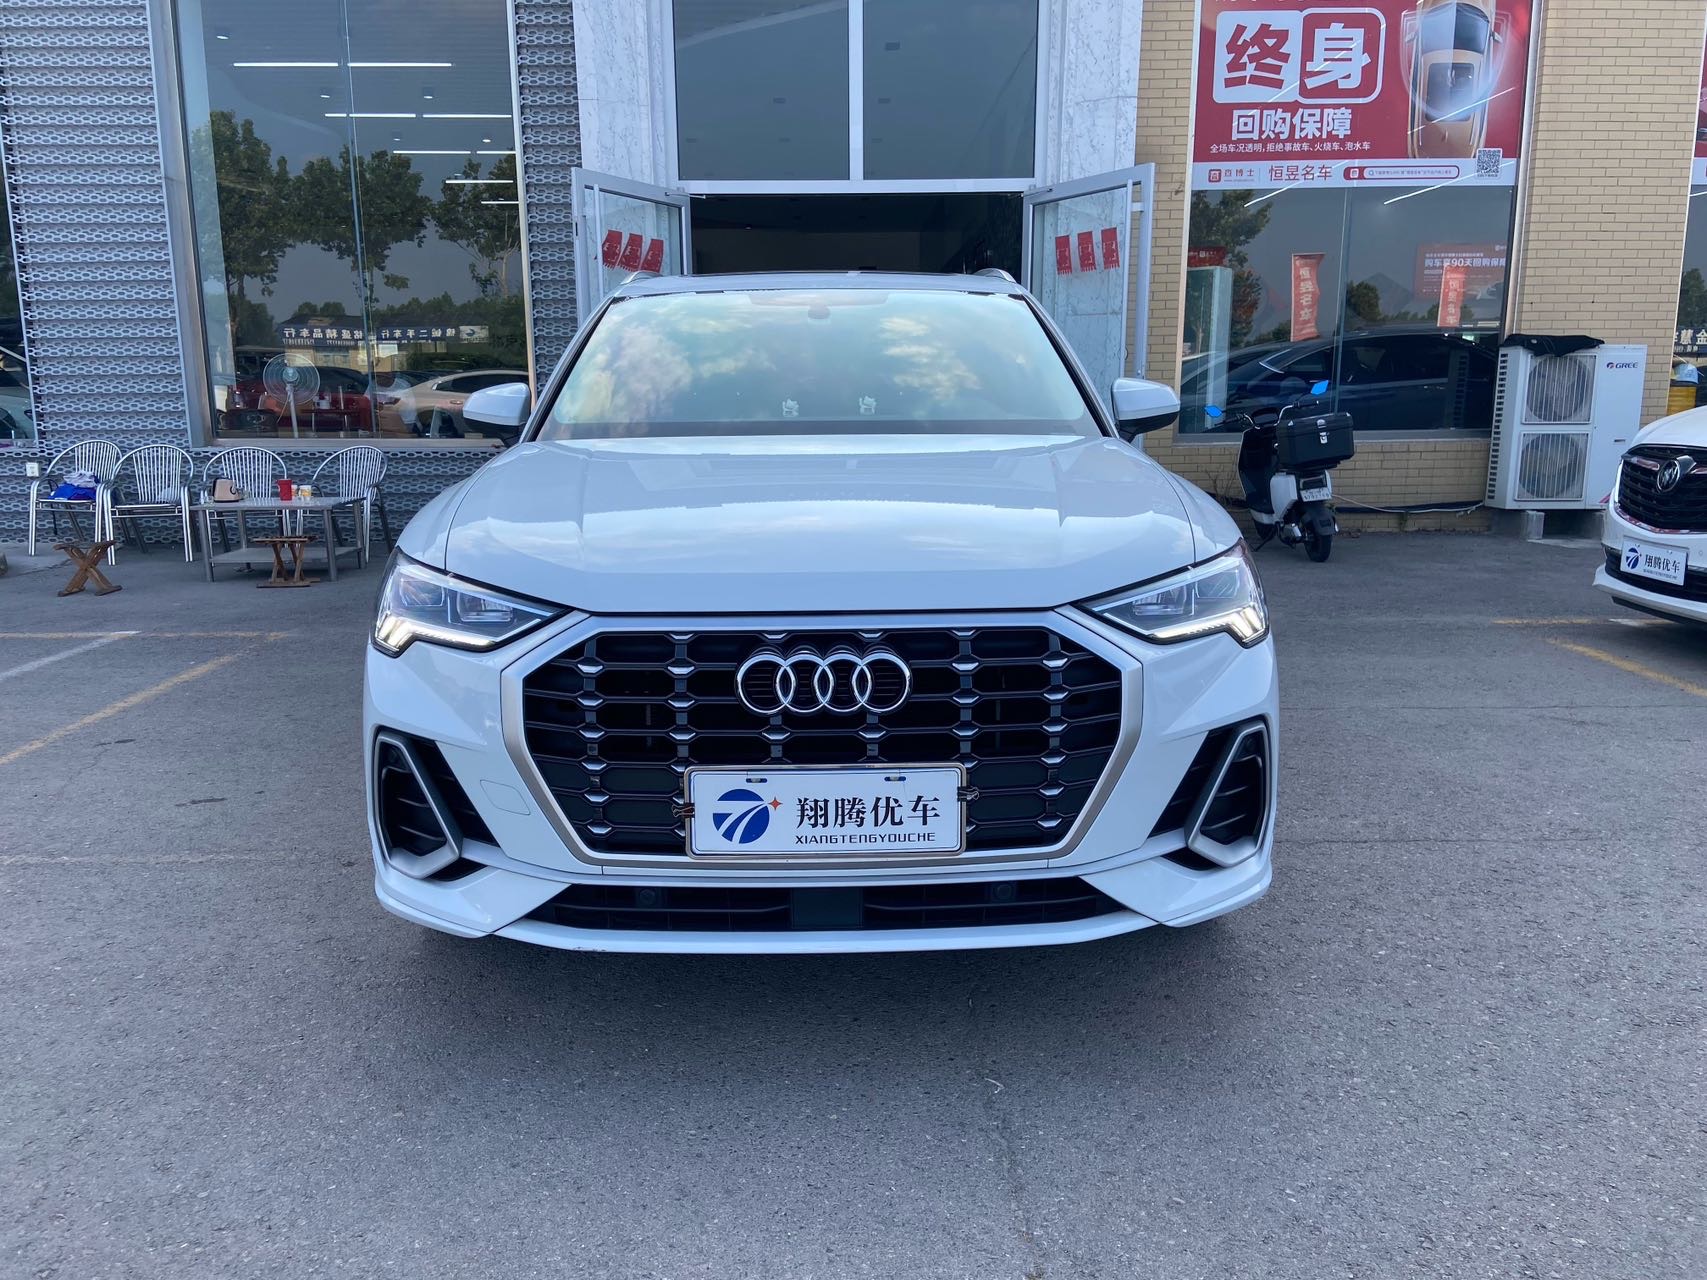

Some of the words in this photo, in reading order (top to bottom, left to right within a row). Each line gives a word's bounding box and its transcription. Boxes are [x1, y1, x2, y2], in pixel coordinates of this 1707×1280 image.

[1224, 22, 1372, 90] 终身
[1231, 107, 1353, 141] 回购保障
[1268, 164, 1333, 182] 恒昱名车
[1615, 361, 1639, 369] GREE
[1644, 554, 1681, 574] 翔腾优车
[796, 795, 941, 829] 翔腾优车
[795, 833, 936, 845] XIANGTENGYOUCHE
